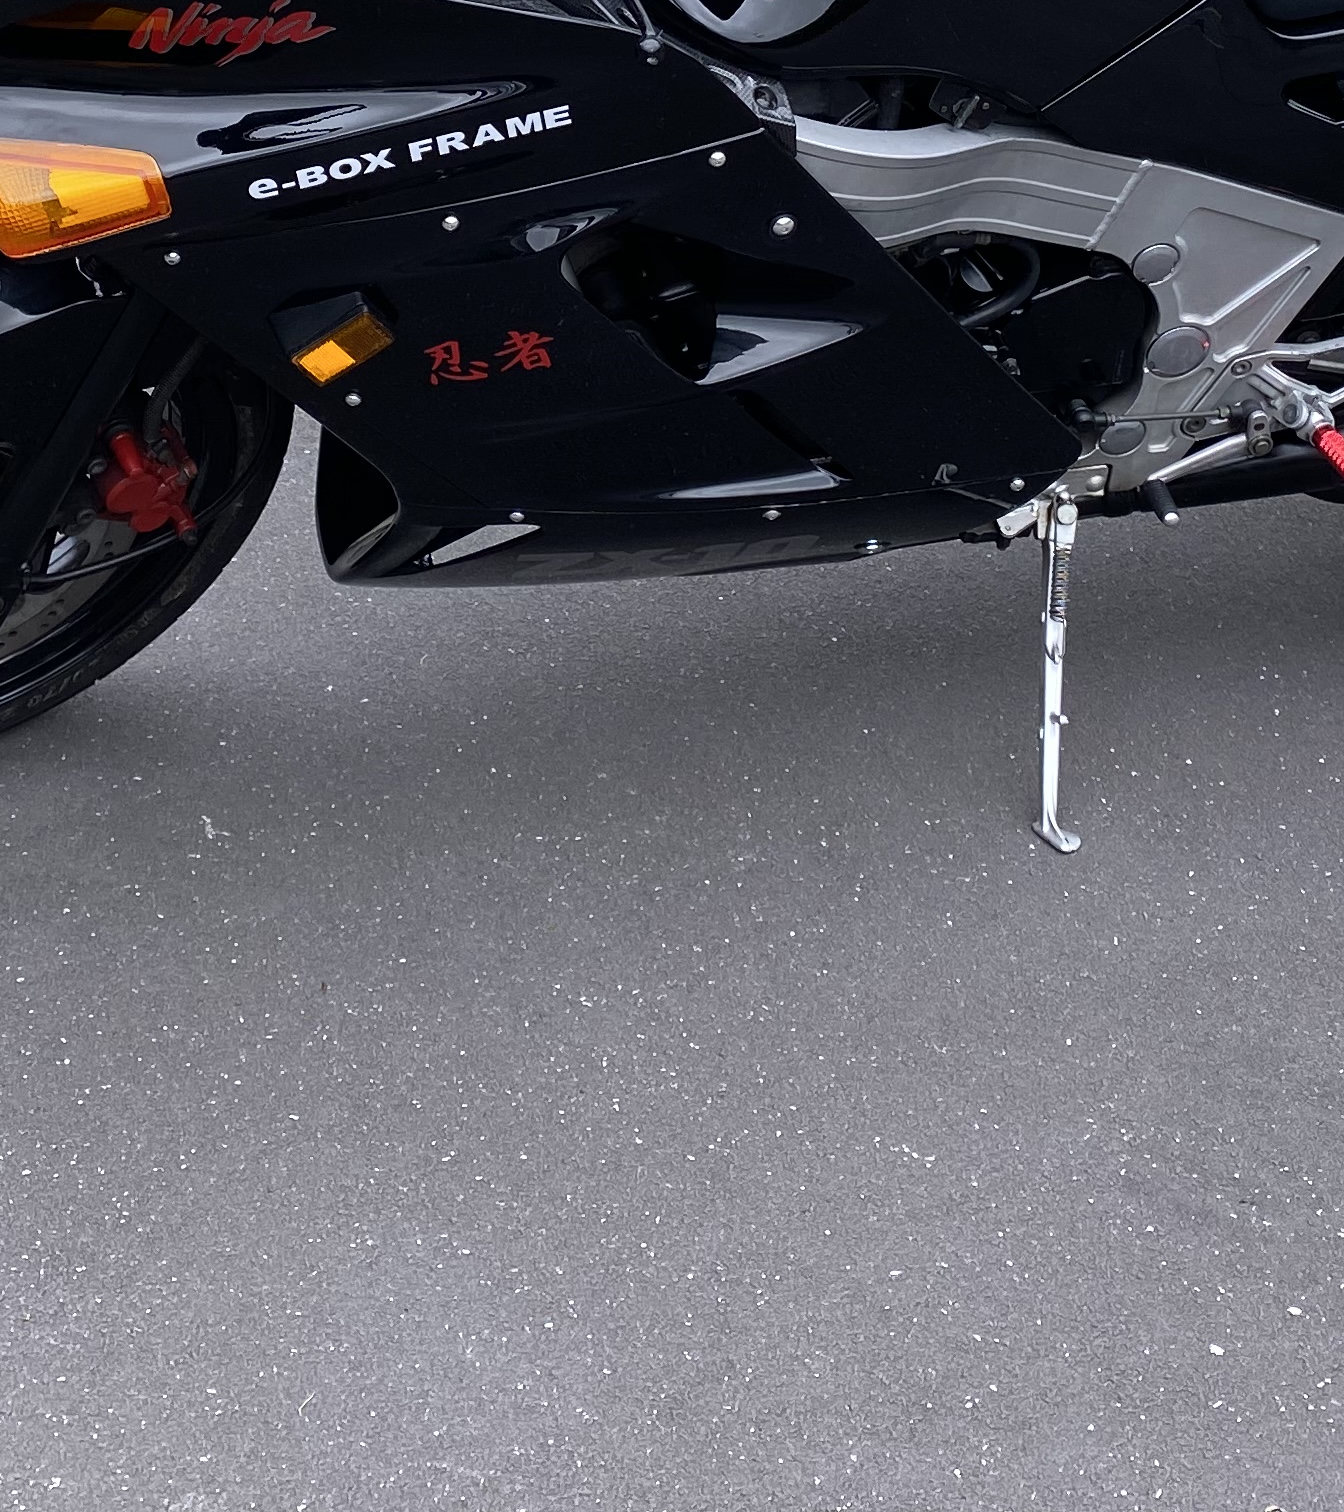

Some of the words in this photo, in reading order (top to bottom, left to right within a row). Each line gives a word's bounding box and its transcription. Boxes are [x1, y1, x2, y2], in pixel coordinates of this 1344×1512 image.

[248, 147, 396, 199] e-BOX
[408, 104, 573, 162] FRAME
[423, 330, 555, 386] 忍者
